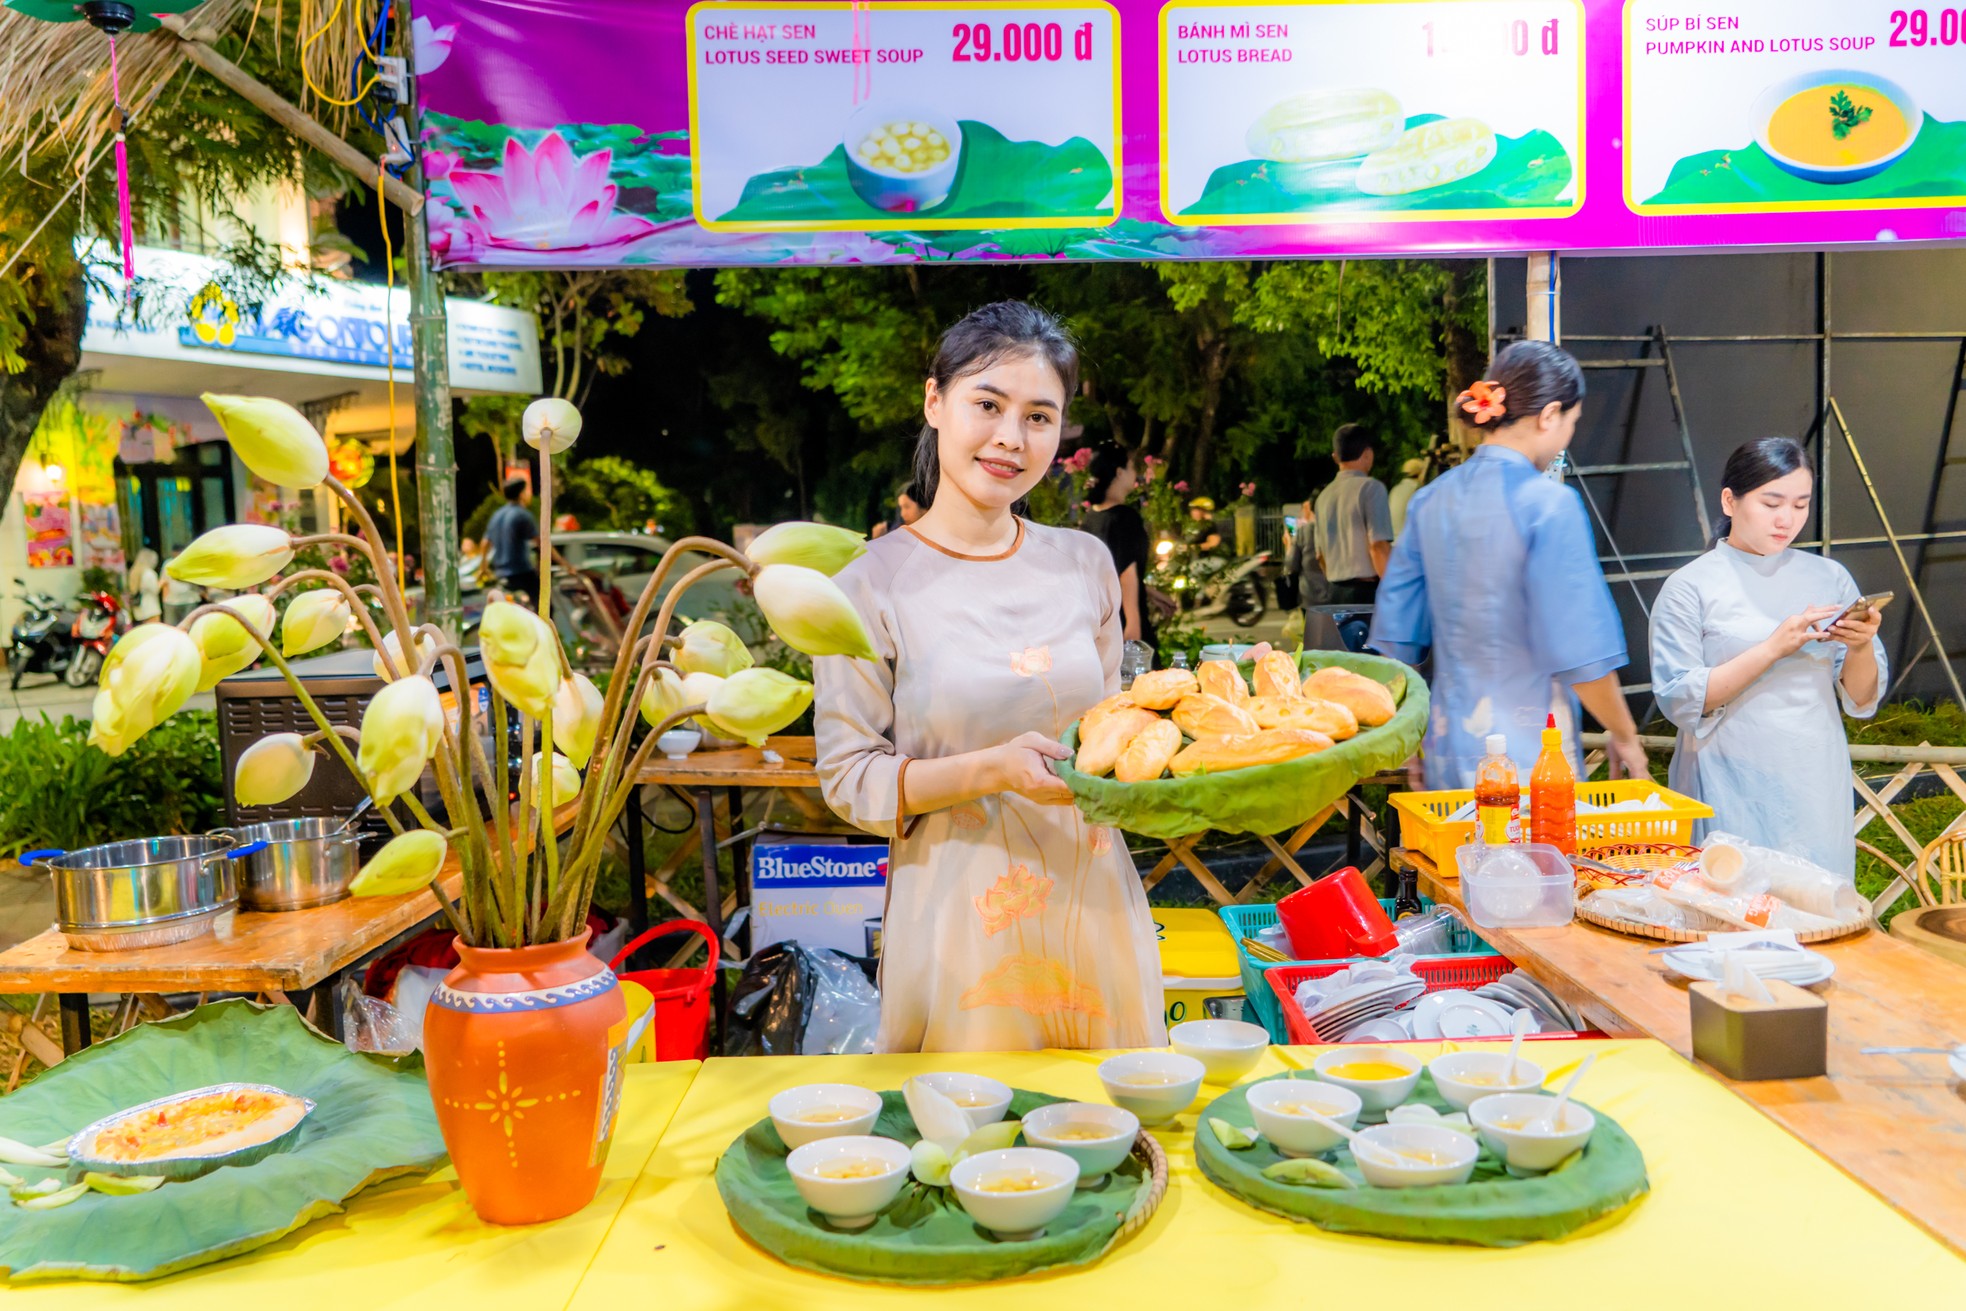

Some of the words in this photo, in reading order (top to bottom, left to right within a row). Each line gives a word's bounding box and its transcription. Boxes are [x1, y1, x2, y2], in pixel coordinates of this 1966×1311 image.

[704, 21, 739, 40] CHÈ
[743, 25, 777, 43] HẠT
[782, 25, 816, 40] SEN
[1178, 21, 1225, 39] BÁNH
[1230, 21, 1250, 38] MÌ
[1255, 24, 1288, 38] SEN
[1646, 14, 1680, 31] SÚP
[1685, 14, 1701, 30] BÍ
[1706, 16, 1739, 30] SEN
[1889, 8, 1966, 47] 29.0
[952, 22, 1063, 62] 29.000
[1074, 22, 1093, 61] đ
[1541, 18, 1559, 55] đ
[1646, 40, 1725, 55] PUMPKIN
[1730, 39, 1765, 53] AND
[1770, 38, 1824, 52] LOTUS
[1829, 36, 1875, 51] SOUP
[705, 50, 761, 65] LOTUS
[766, 50, 809, 64] SEED
[814, 49, 871, 64] SWEET
[877, 49, 924, 63] SOUP
[1178, 49, 1232, 64] LOTUS
[1238, 49, 1293, 63] BREAD
[757, 856, 877, 879] BlueStone
[758, 901, 819, 917] Electric
[823, 901, 863, 915] Oven
